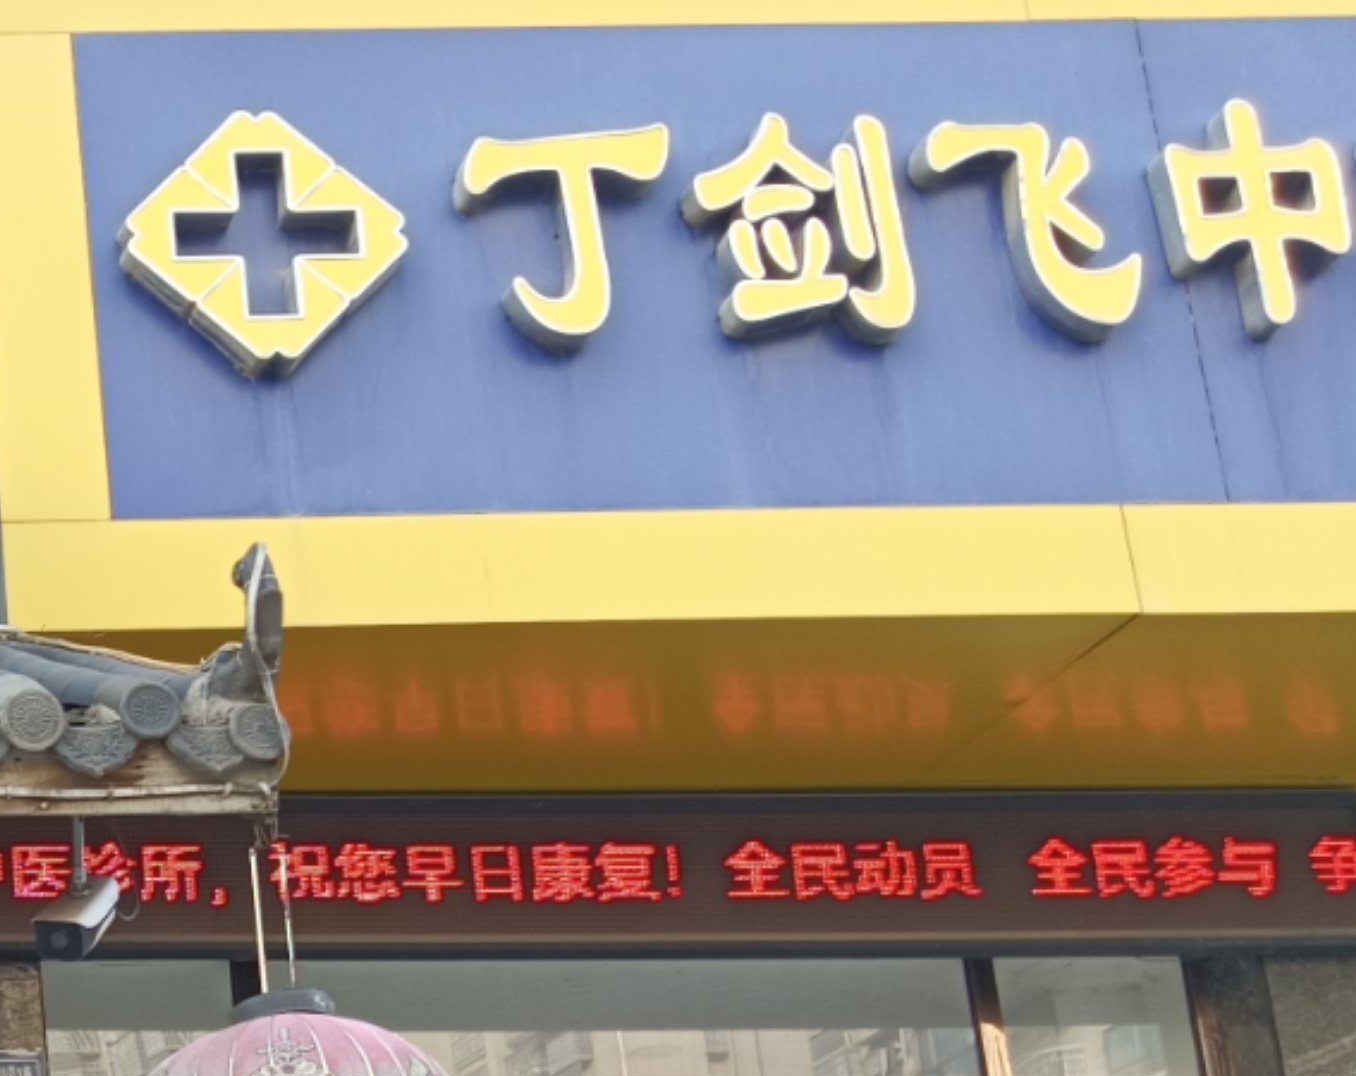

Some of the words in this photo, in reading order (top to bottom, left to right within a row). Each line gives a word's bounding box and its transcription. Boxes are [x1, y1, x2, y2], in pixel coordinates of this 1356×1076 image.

[456, 96, 1352, 348] 丁剑飞中
[724, 840, 984, 900] 全民动员
[1027, 838, 1276, 898] 全民参与
